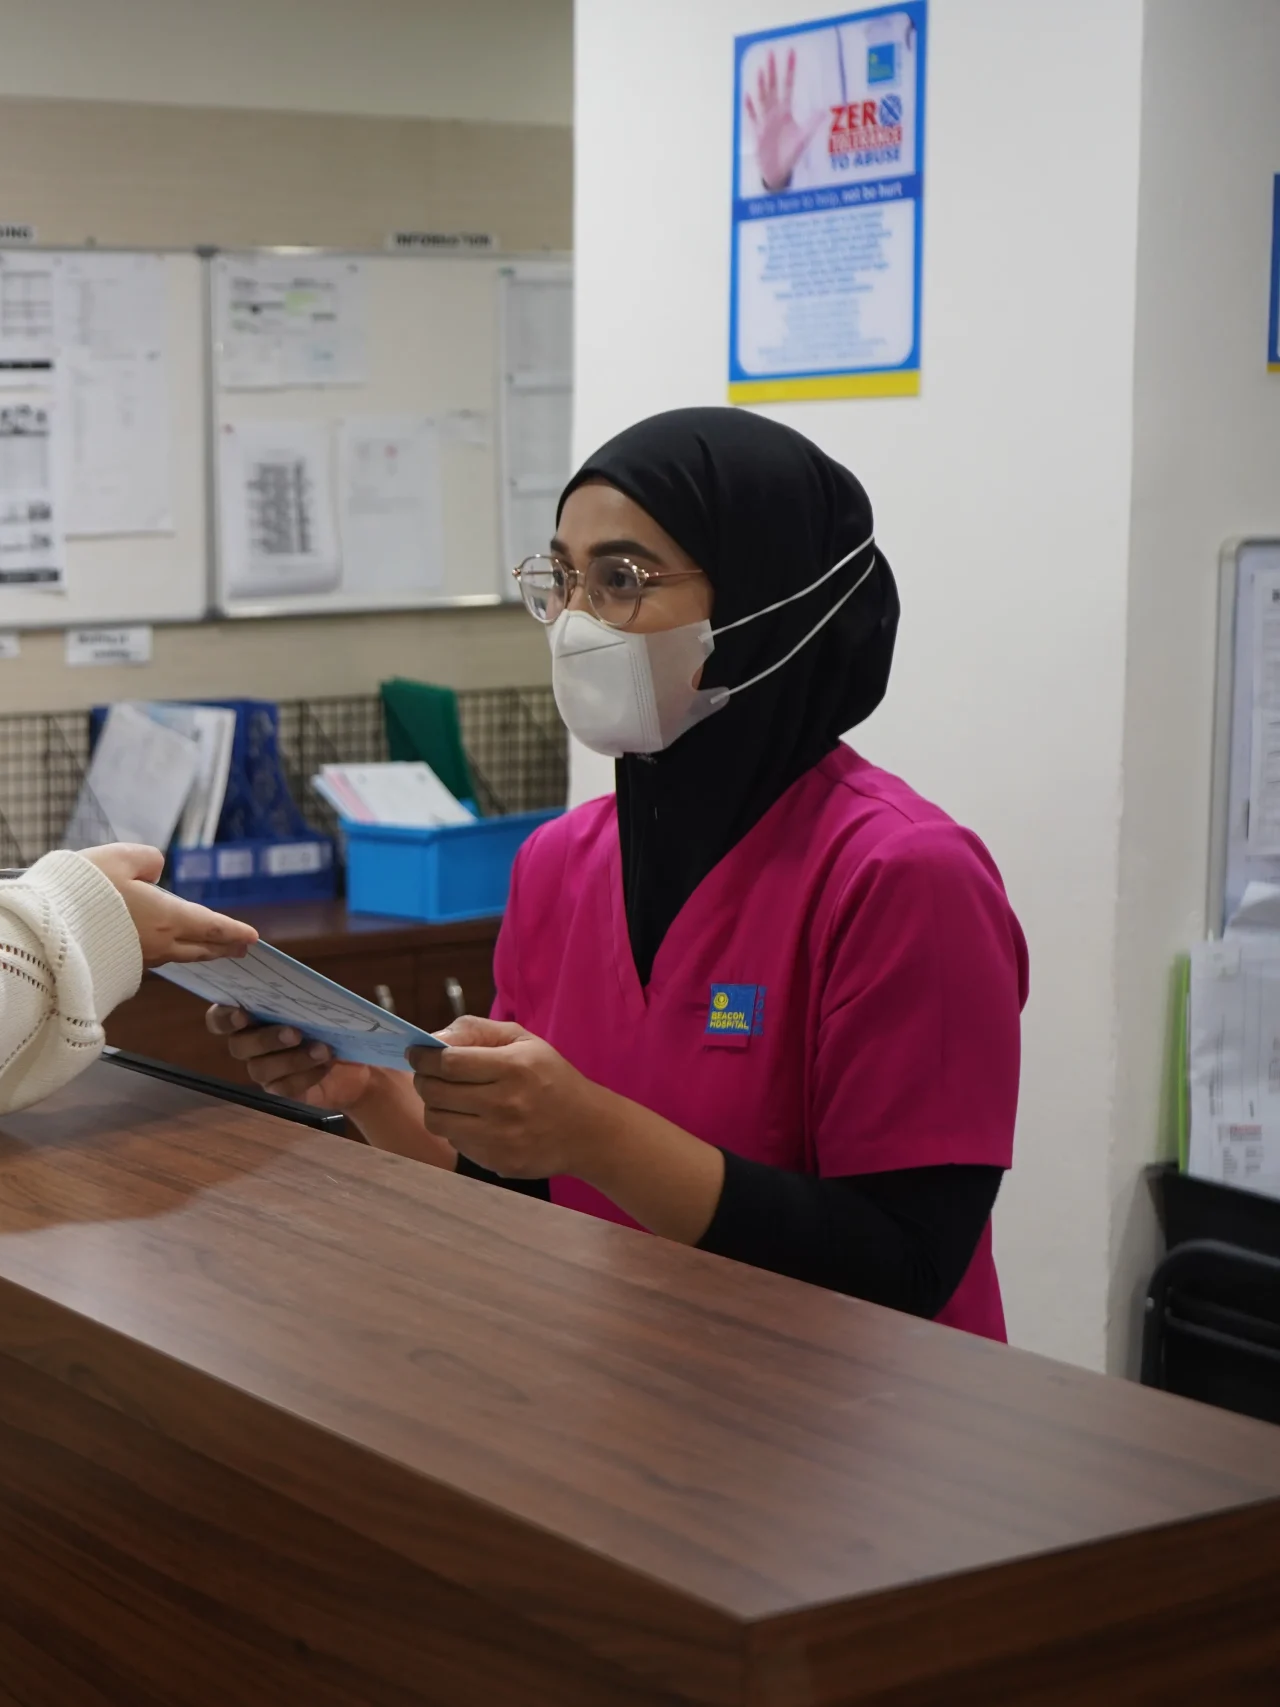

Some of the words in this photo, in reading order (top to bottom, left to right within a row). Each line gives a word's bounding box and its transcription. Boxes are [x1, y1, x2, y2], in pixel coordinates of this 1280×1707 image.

[829, 94, 902, 132] ZERO
[830, 154, 849, 170] TO
[854, 148, 900, 168] ABUSE
[842, 189, 861, 203] not
[862, 185, 876, 199] be
[878, 181, 903, 198] hurt
[709, 1020, 749, 1030] HOSPITAL
[711, 1012, 745, 1020] BEACON
